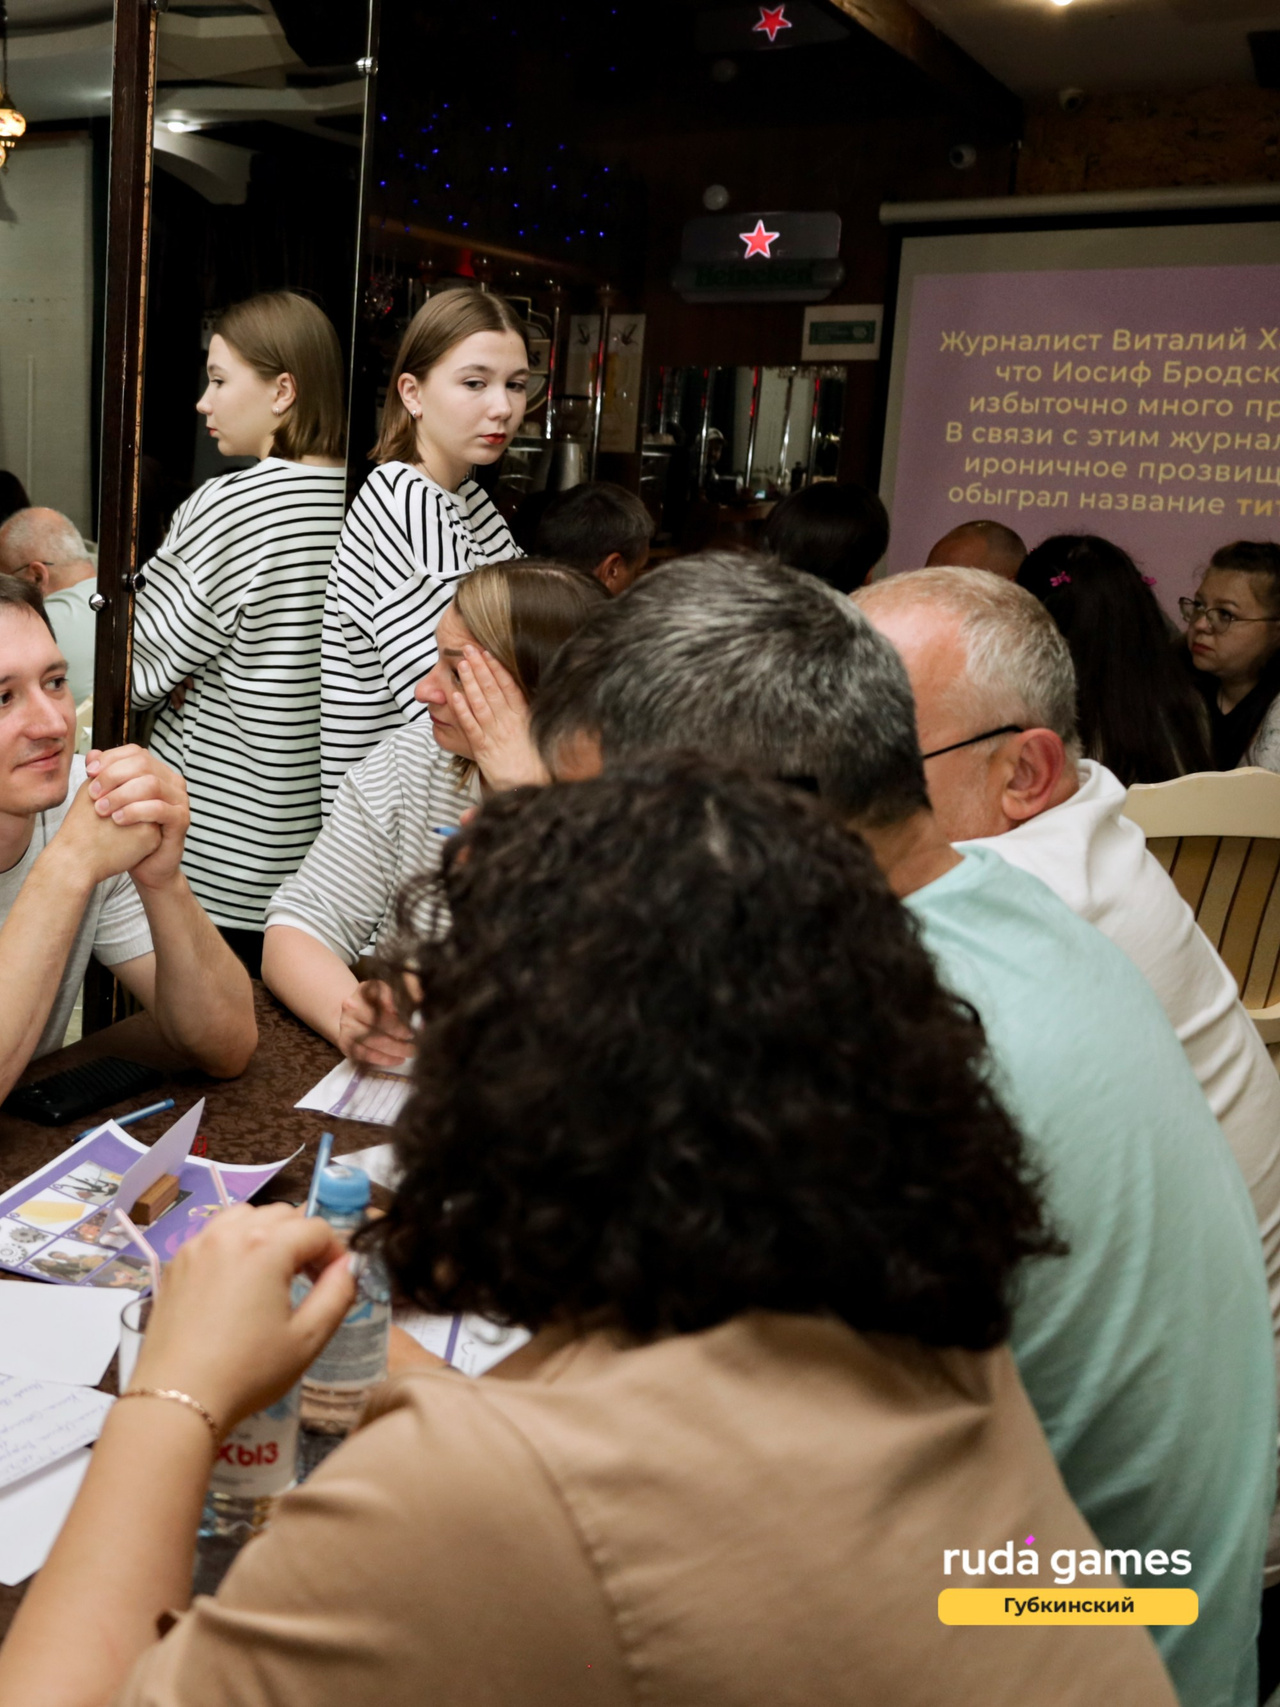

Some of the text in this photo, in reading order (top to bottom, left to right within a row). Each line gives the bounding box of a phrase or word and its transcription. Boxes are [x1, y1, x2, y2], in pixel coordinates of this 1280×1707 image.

[940, 327, 1280, 356] Журналист Виталий Х
[996, 360, 1280, 388] что Иосиф Бродск
[969, 391, 1128, 415] избыточно
[1138, 399, 1234, 416] много
[946, 421, 963, 443] В
[972, 426, 1053, 445] связи
[1063, 429, 1078, 445] с
[1087, 429, 1160, 447] этим
[965, 457, 1280, 486] ироничное прозвищ
[948, 482, 1069, 511] обыграл
[1080, 492, 1225, 514] название
